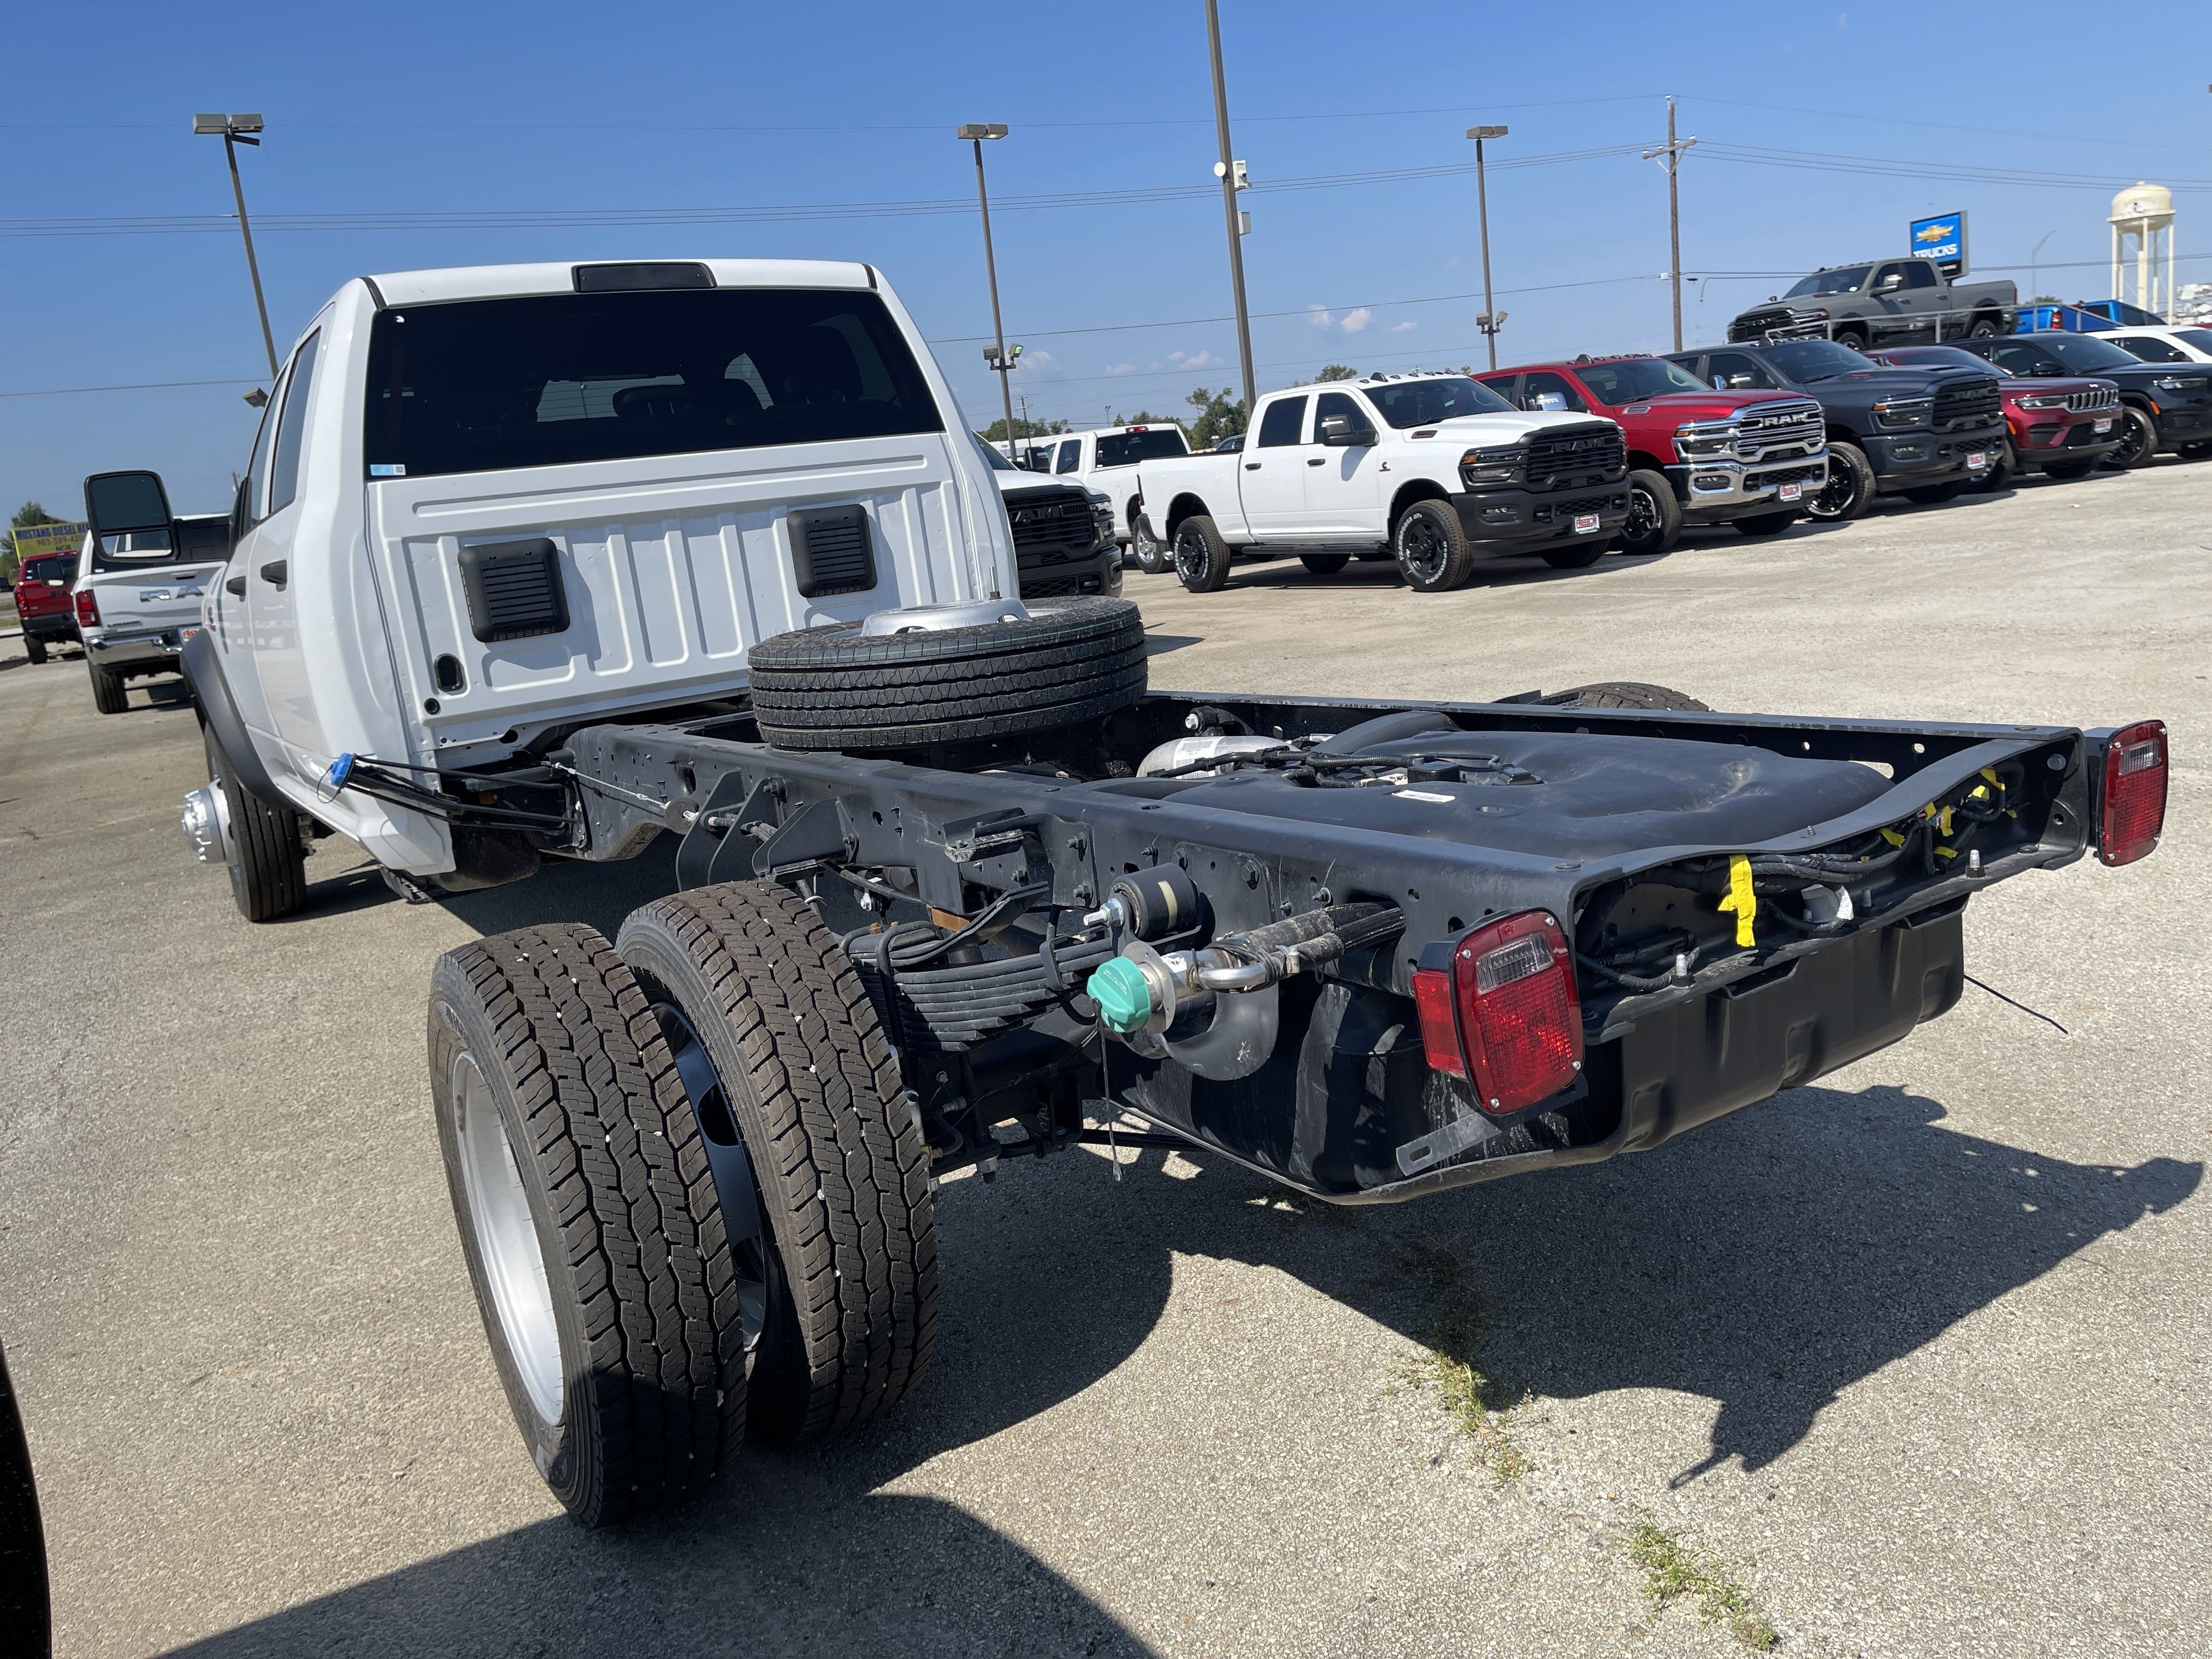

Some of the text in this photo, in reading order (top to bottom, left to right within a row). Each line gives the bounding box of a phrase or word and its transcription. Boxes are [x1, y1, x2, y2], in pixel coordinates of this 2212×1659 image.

[1913, 244, 1957, 258] TRUCKS
[1764, 413, 1808, 426] RAM
[1555, 438, 1605, 452] RAM
[16, 527, 51, 540] MUSTANG
[52, 525, 76, 537] DIESEL
